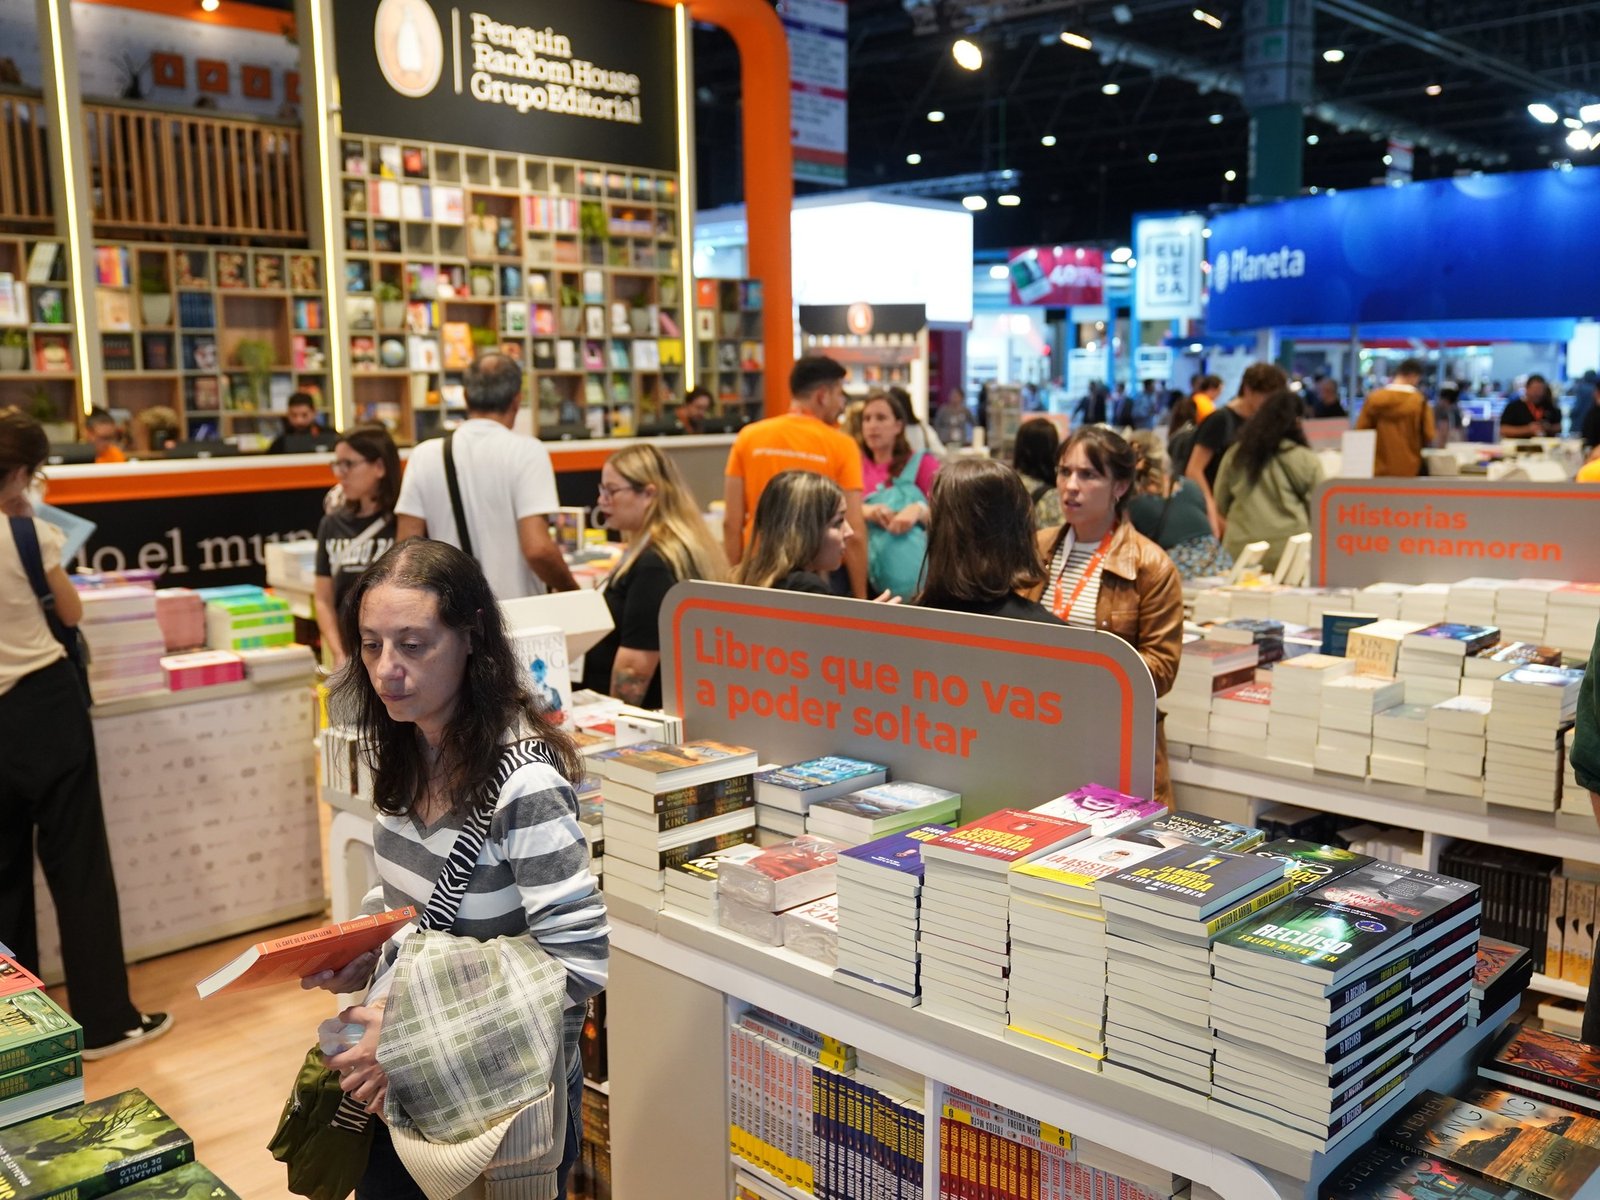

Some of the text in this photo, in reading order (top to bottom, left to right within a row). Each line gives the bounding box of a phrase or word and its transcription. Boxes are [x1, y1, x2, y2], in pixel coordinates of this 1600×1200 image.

[470, 12, 572, 58] Penguin
[473, 42, 641, 95] Random House
[470, 72, 641, 124] Grupo Editorial
[1156, 243, 1182, 257] EU
[1230, 246, 1305, 283] Planeta
[1337, 503, 1469, 531] Historias
[138, 527, 189, 575] el
[1336, 533, 1562, 562] que enamoran
[695, 627, 1063, 725] Libros que no vas
[696, 678, 978, 758] a poder soltar
[665, 814, 688, 829] KING
[950, 829, 1032, 852] ASISTENTA
[1046, 855, 1067, 863] LA
[1375, 863, 1412, 875] ROSSI
[1116, 874, 1206, 898] FREIDA McFADDEN
[1131, 867, 1214, 892] DE ARRIBA
[1253, 924, 1352, 954] RECLUSO
[1308, 926, 1324, 934] EL
[1238, 934, 1338, 963] FREIDA McFADEN
[1350, 981, 1367, 1000] RECLUSO
[792, 1040, 807, 1054] FREIDA
[1344, 1031, 1361, 1052] RECLUSO
[986, 1122, 1004, 1136] FREIDA
[1007, 1118, 1026, 1132] FREIDA
[1396, 1097, 1444, 1139] STEPHEN
[1020, 1134, 1036, 1147] VIGILA
[1040, 1141, 1065, 1158] ASISTENTA
[119, 1164, 162, 1186] BRAZALES
[120, 1157, 162, 1177] DE DUELO
